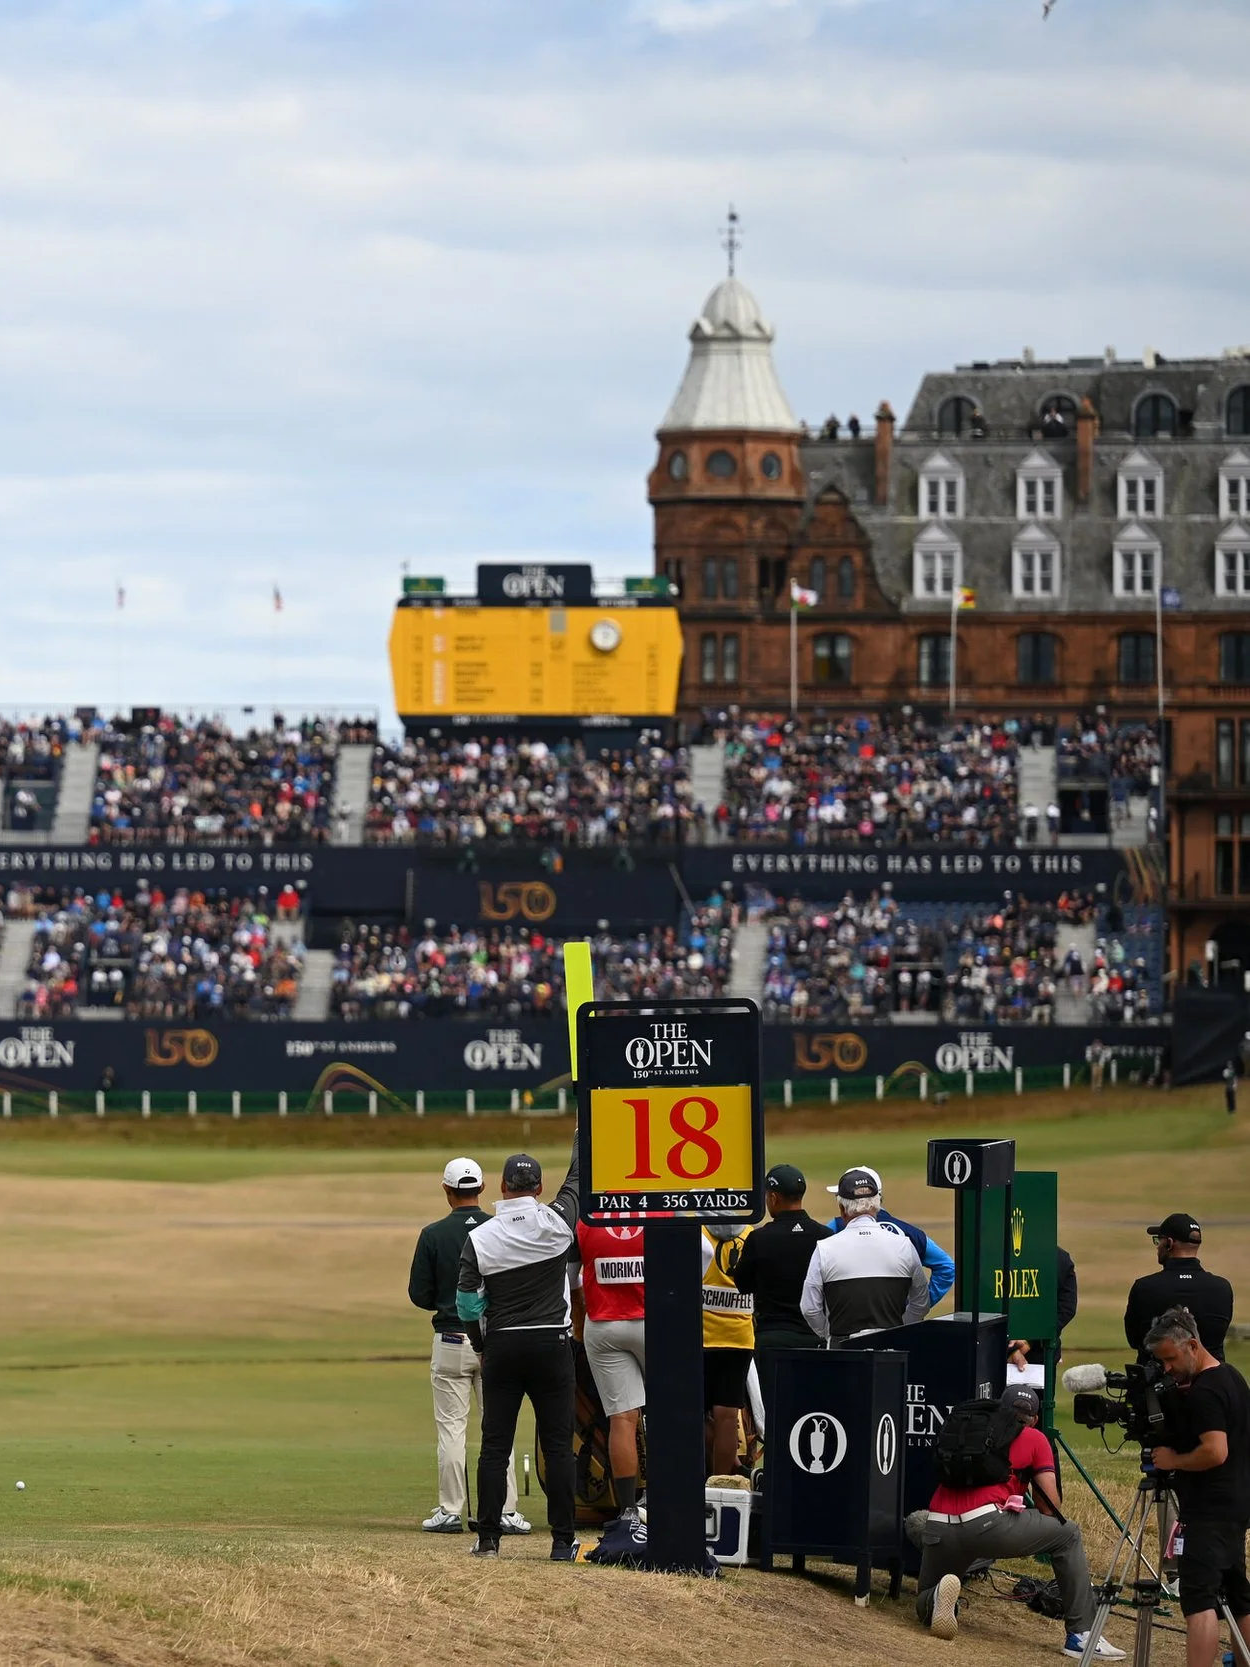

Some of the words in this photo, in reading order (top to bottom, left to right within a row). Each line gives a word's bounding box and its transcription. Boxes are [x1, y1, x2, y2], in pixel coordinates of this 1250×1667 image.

[120, 852, 165, 870] HAS
[172, 852, 215, 870] LED
[223, 852, 253, 870] TO
[261, 852, 313, 870] THIS
[732, 854, 879, 872] EVERYTHING
[887, 854, 931, 872] HAS
[940, 854, 983, 872] LED
[992, 854, 1021, 872] TO
[1030, 854, 1082, 872] THIS
[650, 1023, 688, 1039] THE
[145, 1028, 218, 1067] 150
[464, 1040, 542, 1070] OPEN
[625, 1037, 713, 1069] OPEN
[794, 1032, 868, 1071] 150
[936, 1043, 1014, 1073] OPEN
[622, 1097, 722, 1179] 18
[599, 1196, 631, 1209] PAR
[638, 1196, 648, 1208] 4
[662, 1195, 689, 1208] 356
[693, 1194, 748, 1208] YARDS
[994, 1269, 1040, 1298] RLEX
[979, 1382, 990, 1399] THE
[905, 1403, 954, 1436] EN
